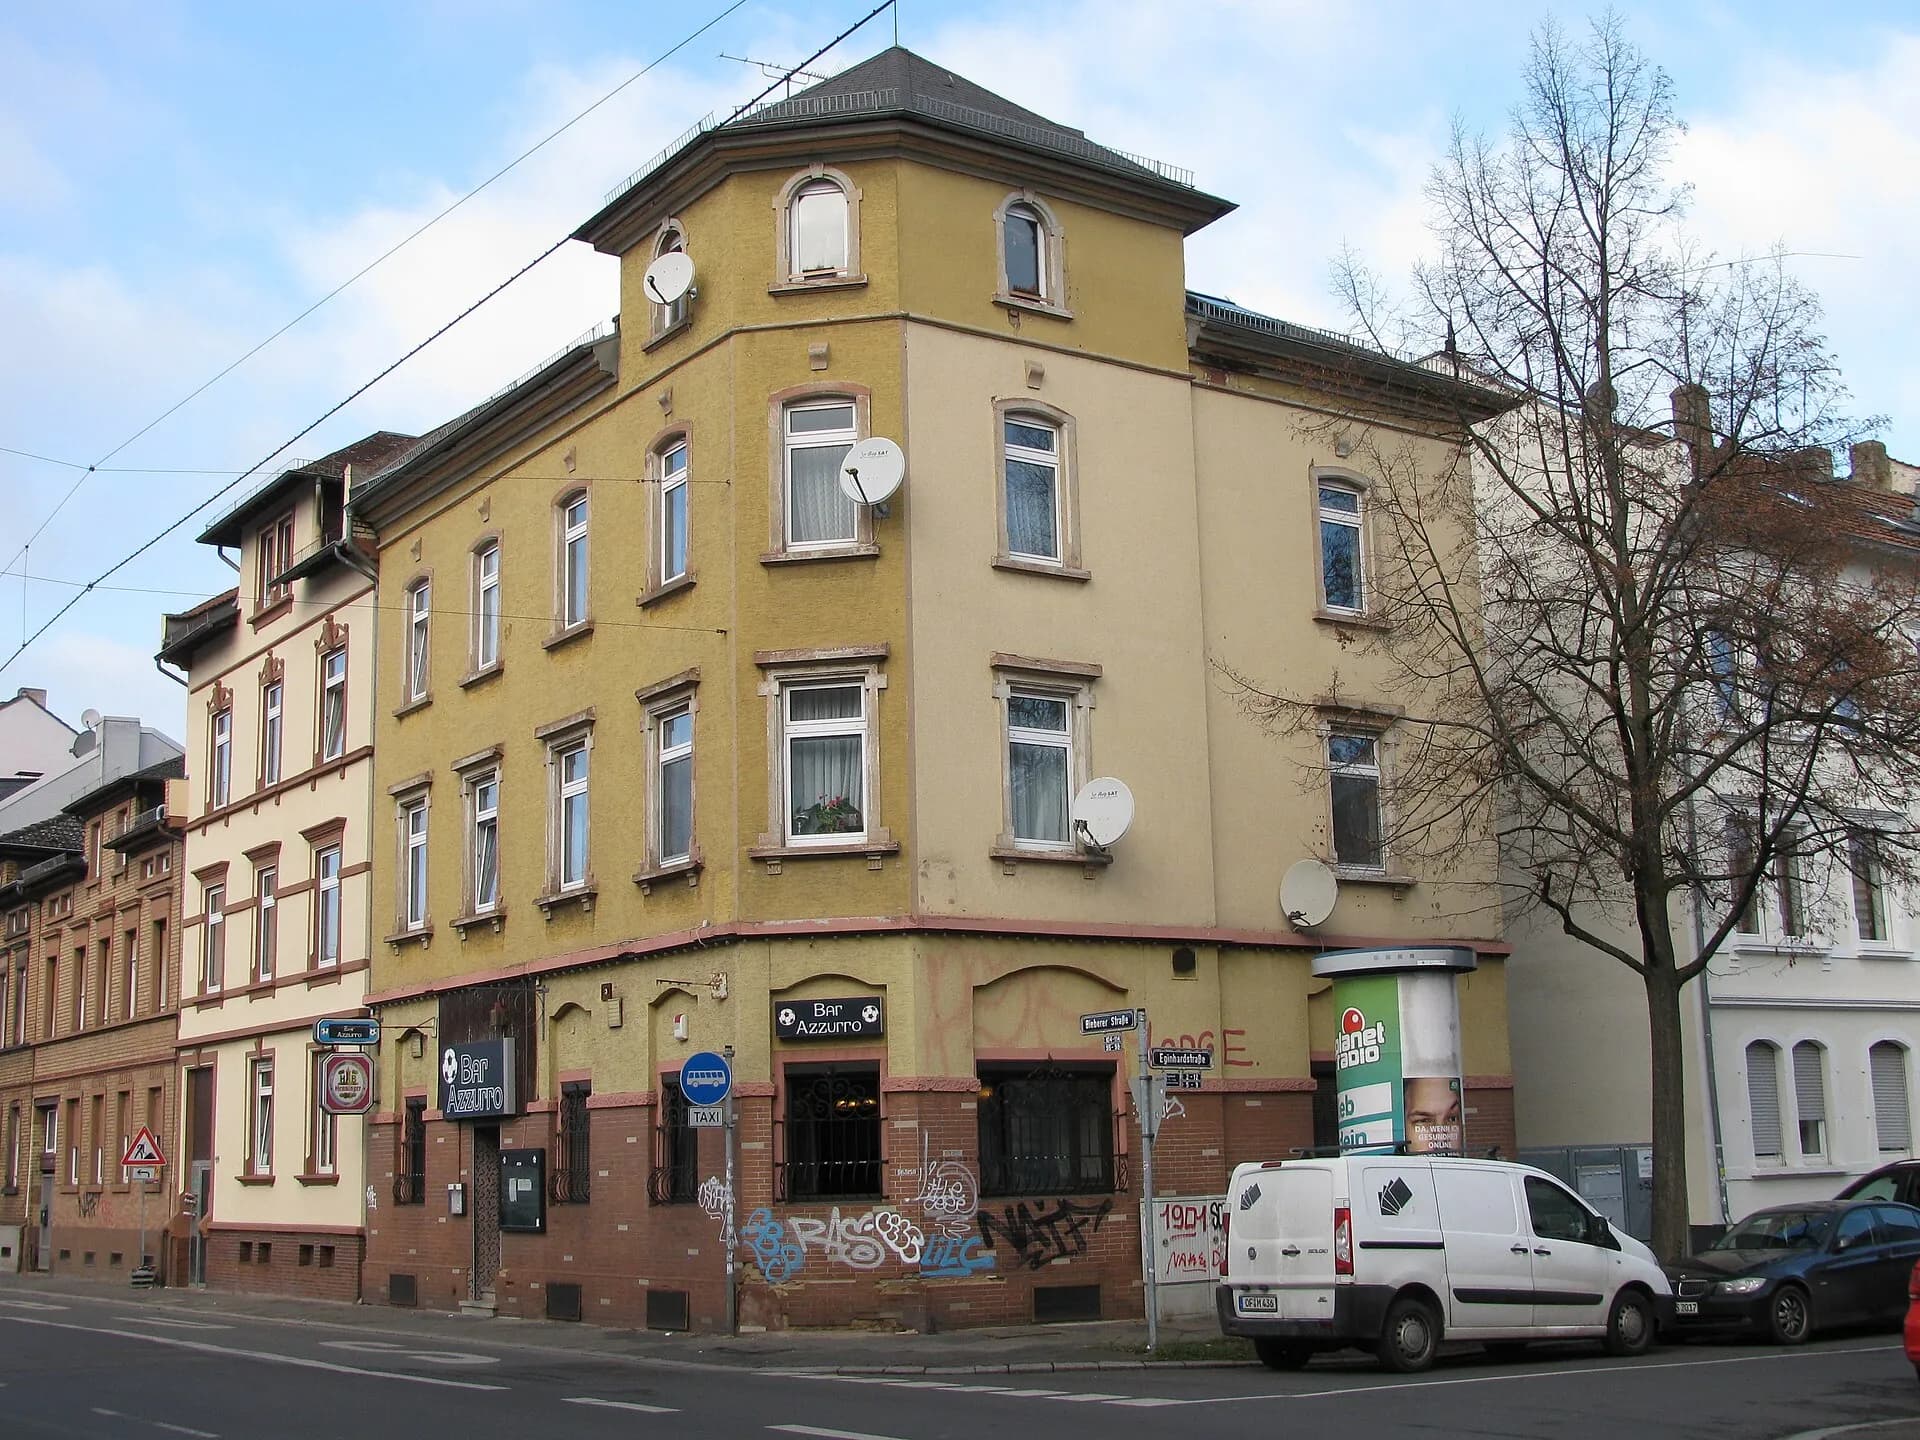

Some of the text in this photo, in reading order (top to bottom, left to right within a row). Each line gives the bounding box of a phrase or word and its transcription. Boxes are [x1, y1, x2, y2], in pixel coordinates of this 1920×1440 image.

[796, 1020, 862, 1035] Azzurro
[1085, 1013, 1129, 1029] Bieberer Straße
[1160, 1053, 1206, 1065] Eginhardstraße
[460, 1054, 488, 1084] Bar
[446, 1084, 504, 1113] Azzurro
[694, 1112, 719, 1122] TAXI
